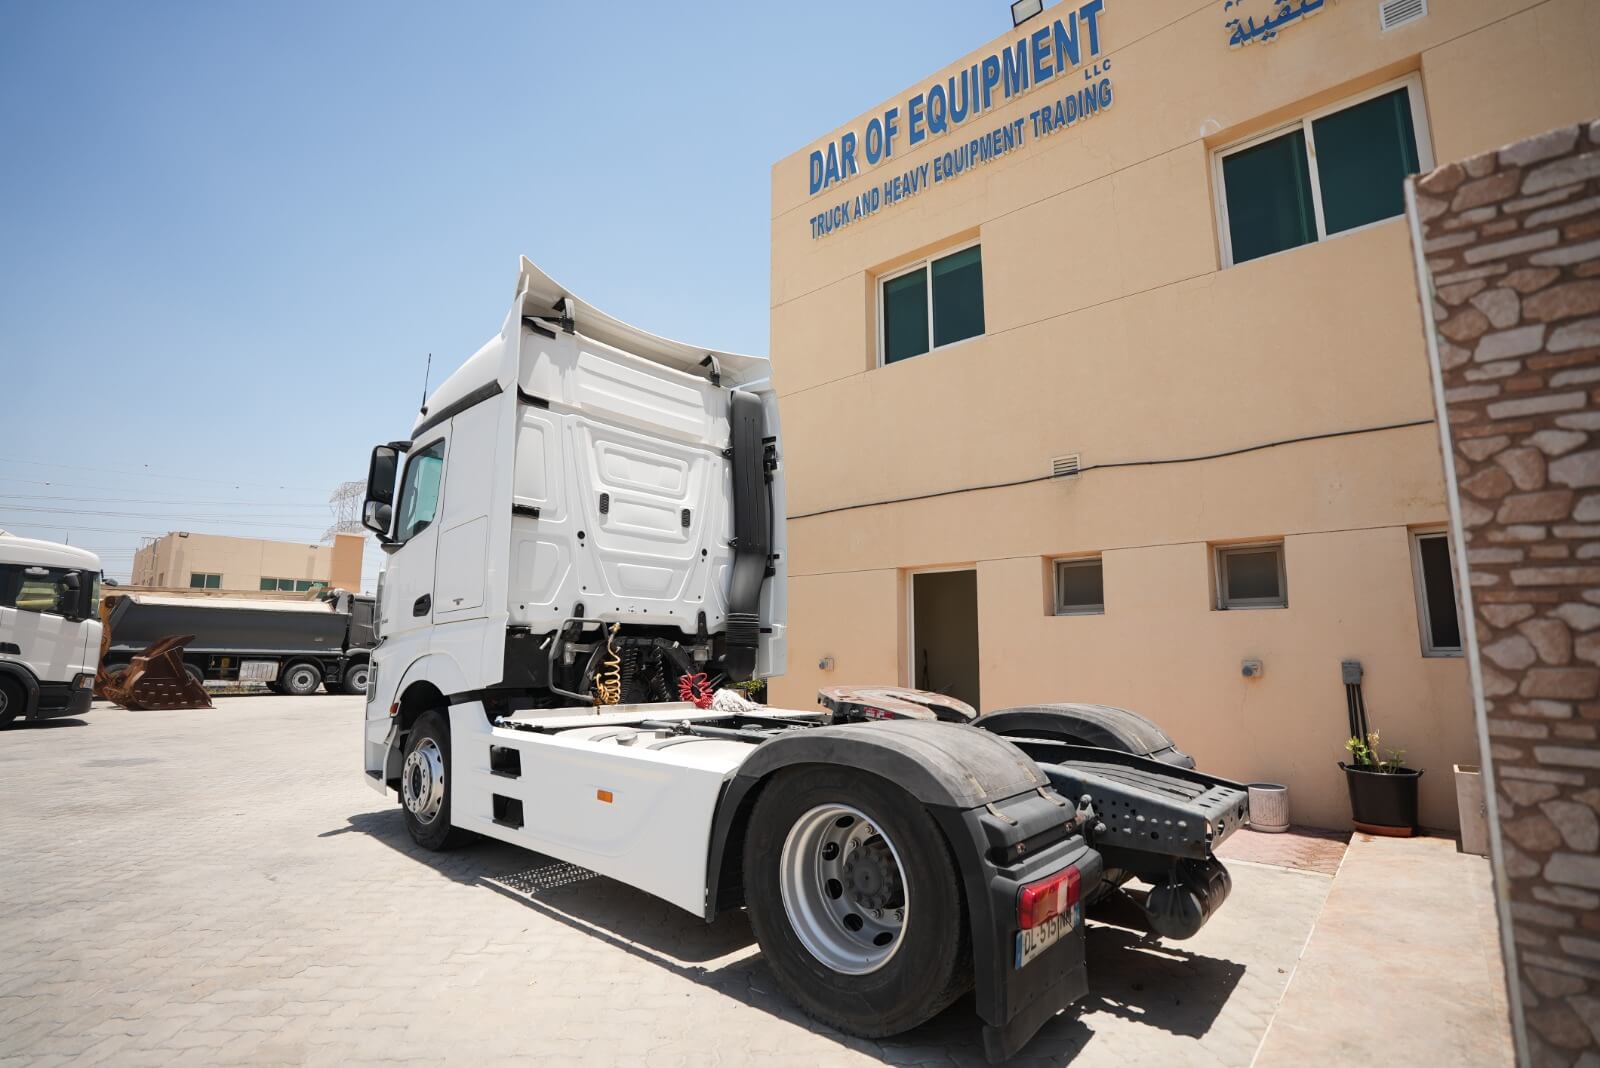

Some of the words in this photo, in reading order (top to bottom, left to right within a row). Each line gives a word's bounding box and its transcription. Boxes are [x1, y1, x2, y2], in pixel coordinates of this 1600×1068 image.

[809, 131, 858, 196] DAR
[865, 106, 899, 166] OF
[908, 0, 1104, 146] EQUIPMENT
[1085, 58, 1112, 80] LLC
[810, 200, 851, 240] TRUCK
[853, 186, 880, 220] AND
[884, 162, 929, 206] HEAVY
[934, 117, 1025, 184] EQUIPMENT
[1029, 78, 1113, 139] TRADING
